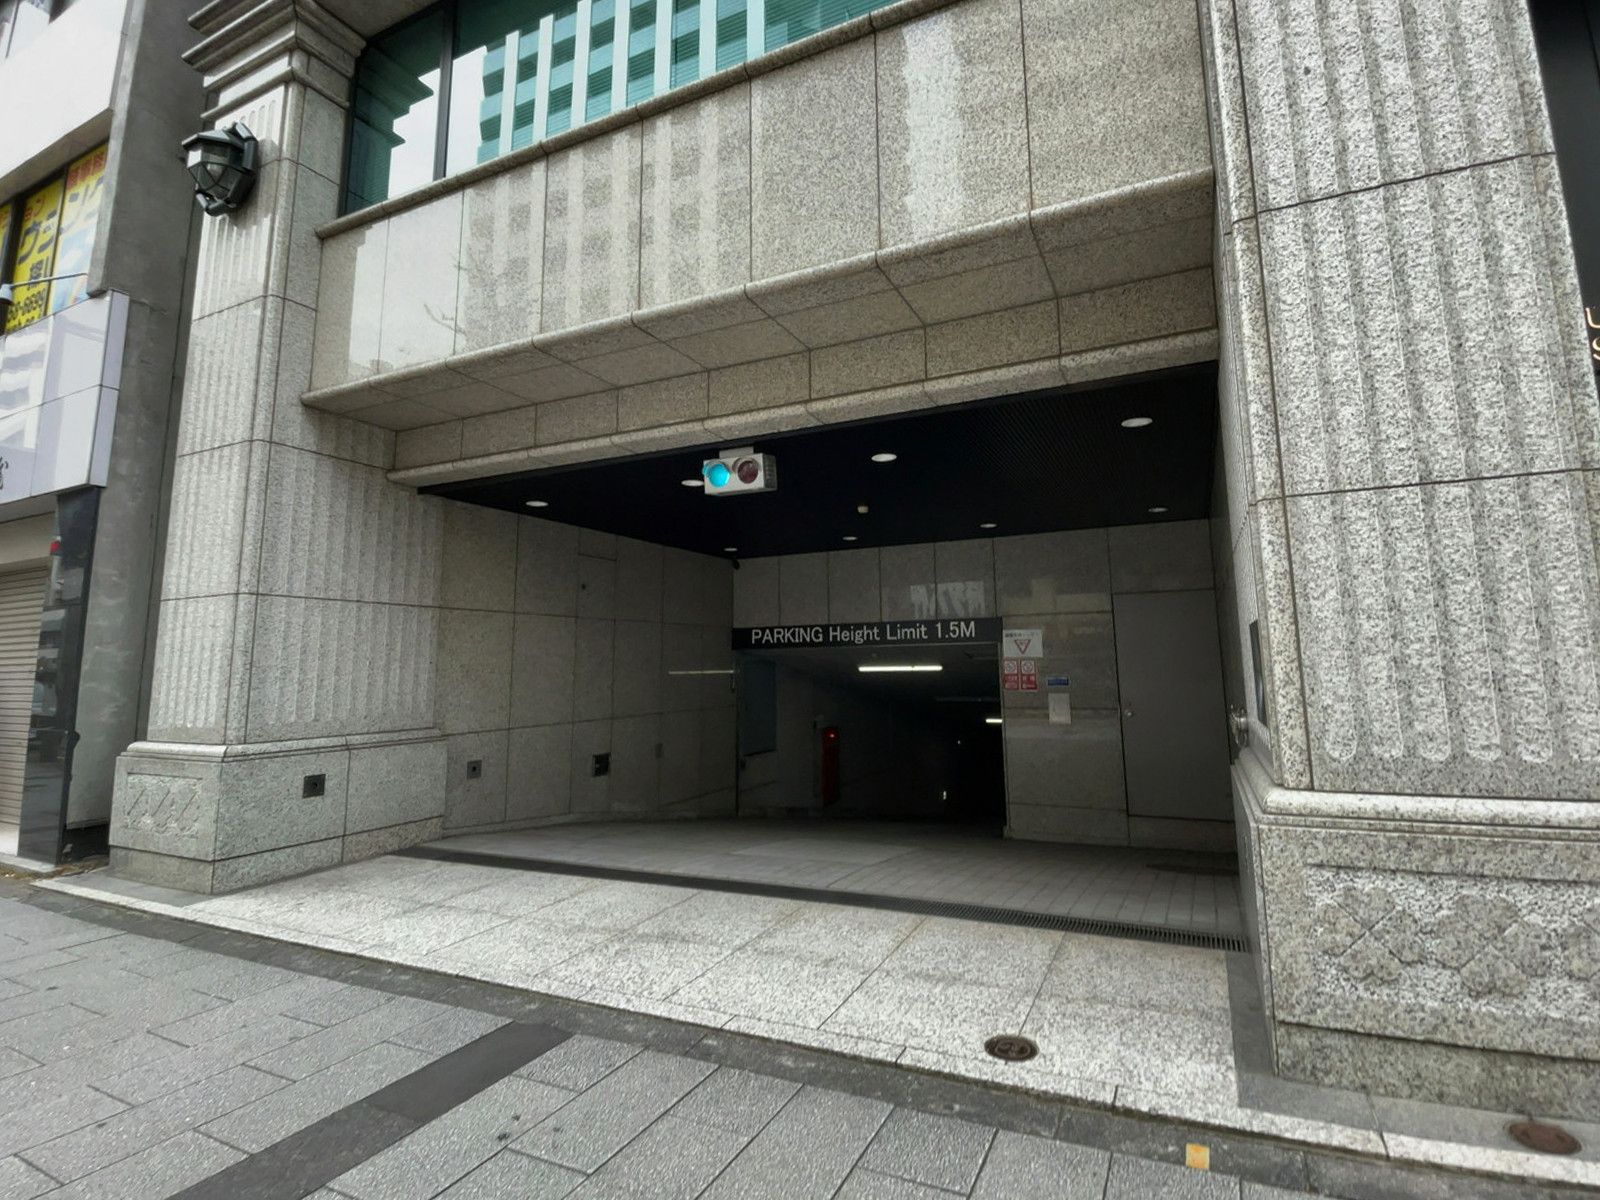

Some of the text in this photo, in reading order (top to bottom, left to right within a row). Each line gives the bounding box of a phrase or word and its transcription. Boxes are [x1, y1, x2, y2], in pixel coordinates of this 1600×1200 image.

[751, 620, 976, 644] PARKING Height Limit 1.5M
